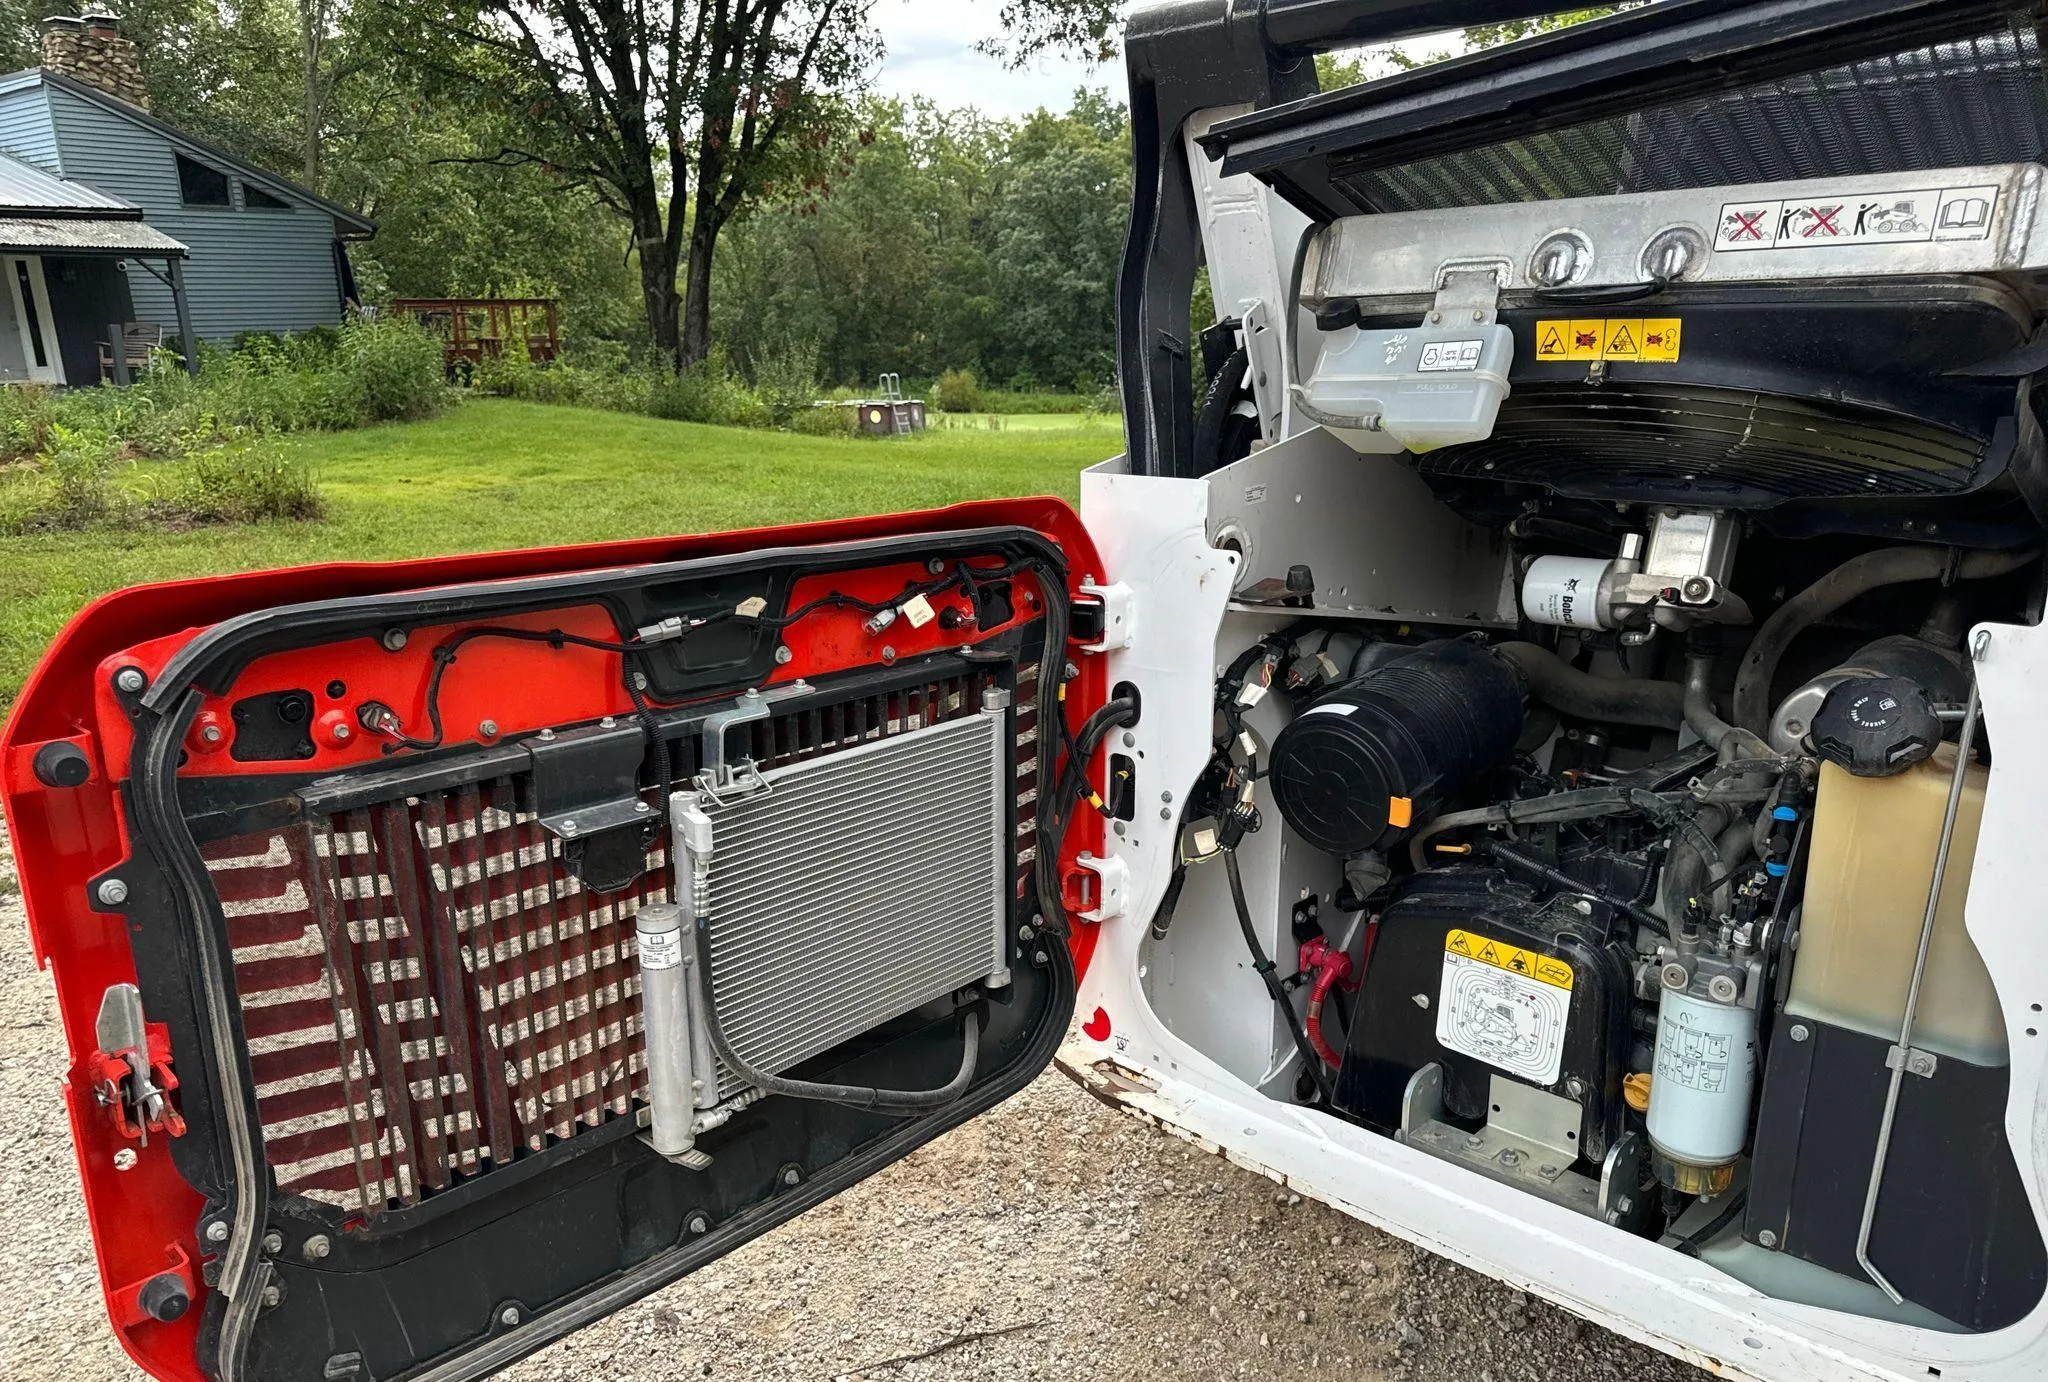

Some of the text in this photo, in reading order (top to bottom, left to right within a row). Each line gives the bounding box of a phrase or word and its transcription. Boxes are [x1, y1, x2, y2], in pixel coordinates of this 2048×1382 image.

[1562, 595, 1575, 624] Bobcat
[1850, 696, 1886, 728] DIESEL FUEL ONLY
